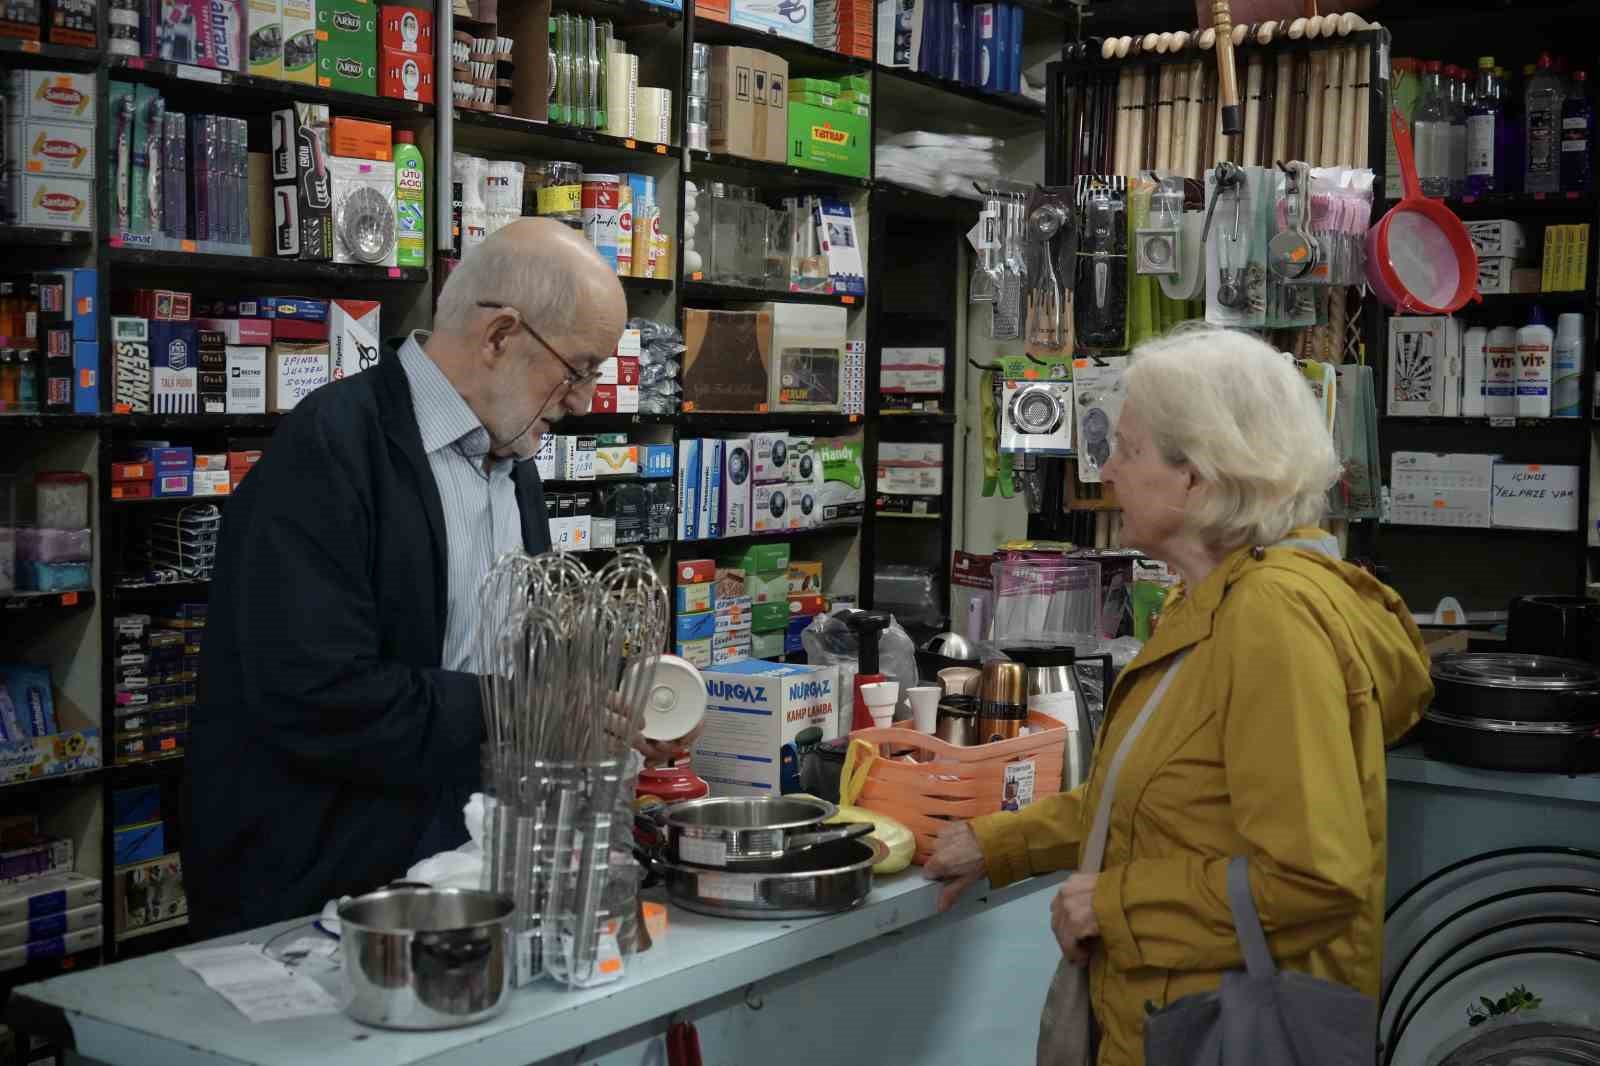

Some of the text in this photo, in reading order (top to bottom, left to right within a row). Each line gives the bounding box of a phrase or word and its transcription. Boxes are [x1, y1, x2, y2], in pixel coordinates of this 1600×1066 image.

[336, 15, 359, 28] ARKO
[338, 62, 361, 73] ARKO
[132, 342, 151, 413] PERMA
[706, 679, 767, 704] NURGAZ
[789, 679, 832, 702] NURGAZ
[786, 709, 807, 724] KAMP
[807, 702, 833, 719] LAMBA
